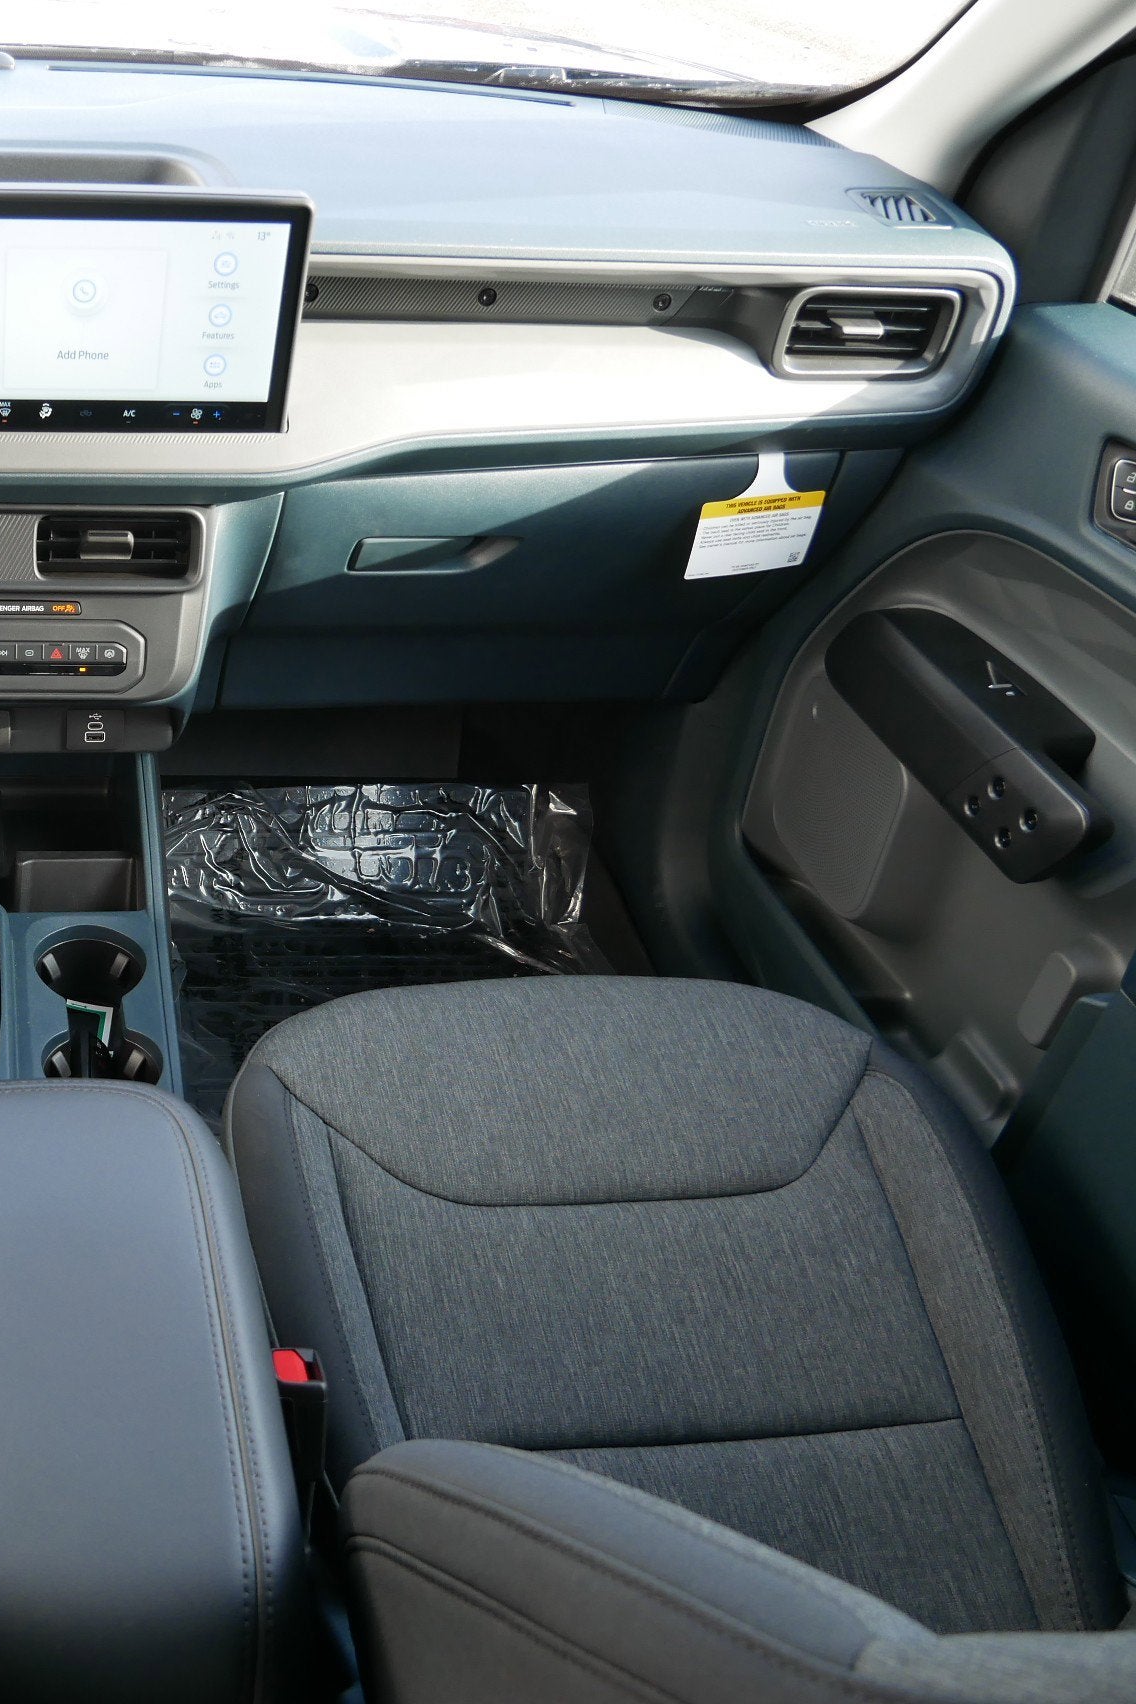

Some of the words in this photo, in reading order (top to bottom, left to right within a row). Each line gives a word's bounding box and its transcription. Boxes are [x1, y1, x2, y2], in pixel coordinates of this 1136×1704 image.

[208, 280, 240, 290] Settings
[201, 332, 236, 340] Features
[56, 350, 76, 360] Add
[78, 350, 110, 360] Phone
[204, 380, 223, 390] Apps
[122, 410, 136, 418] A/C
